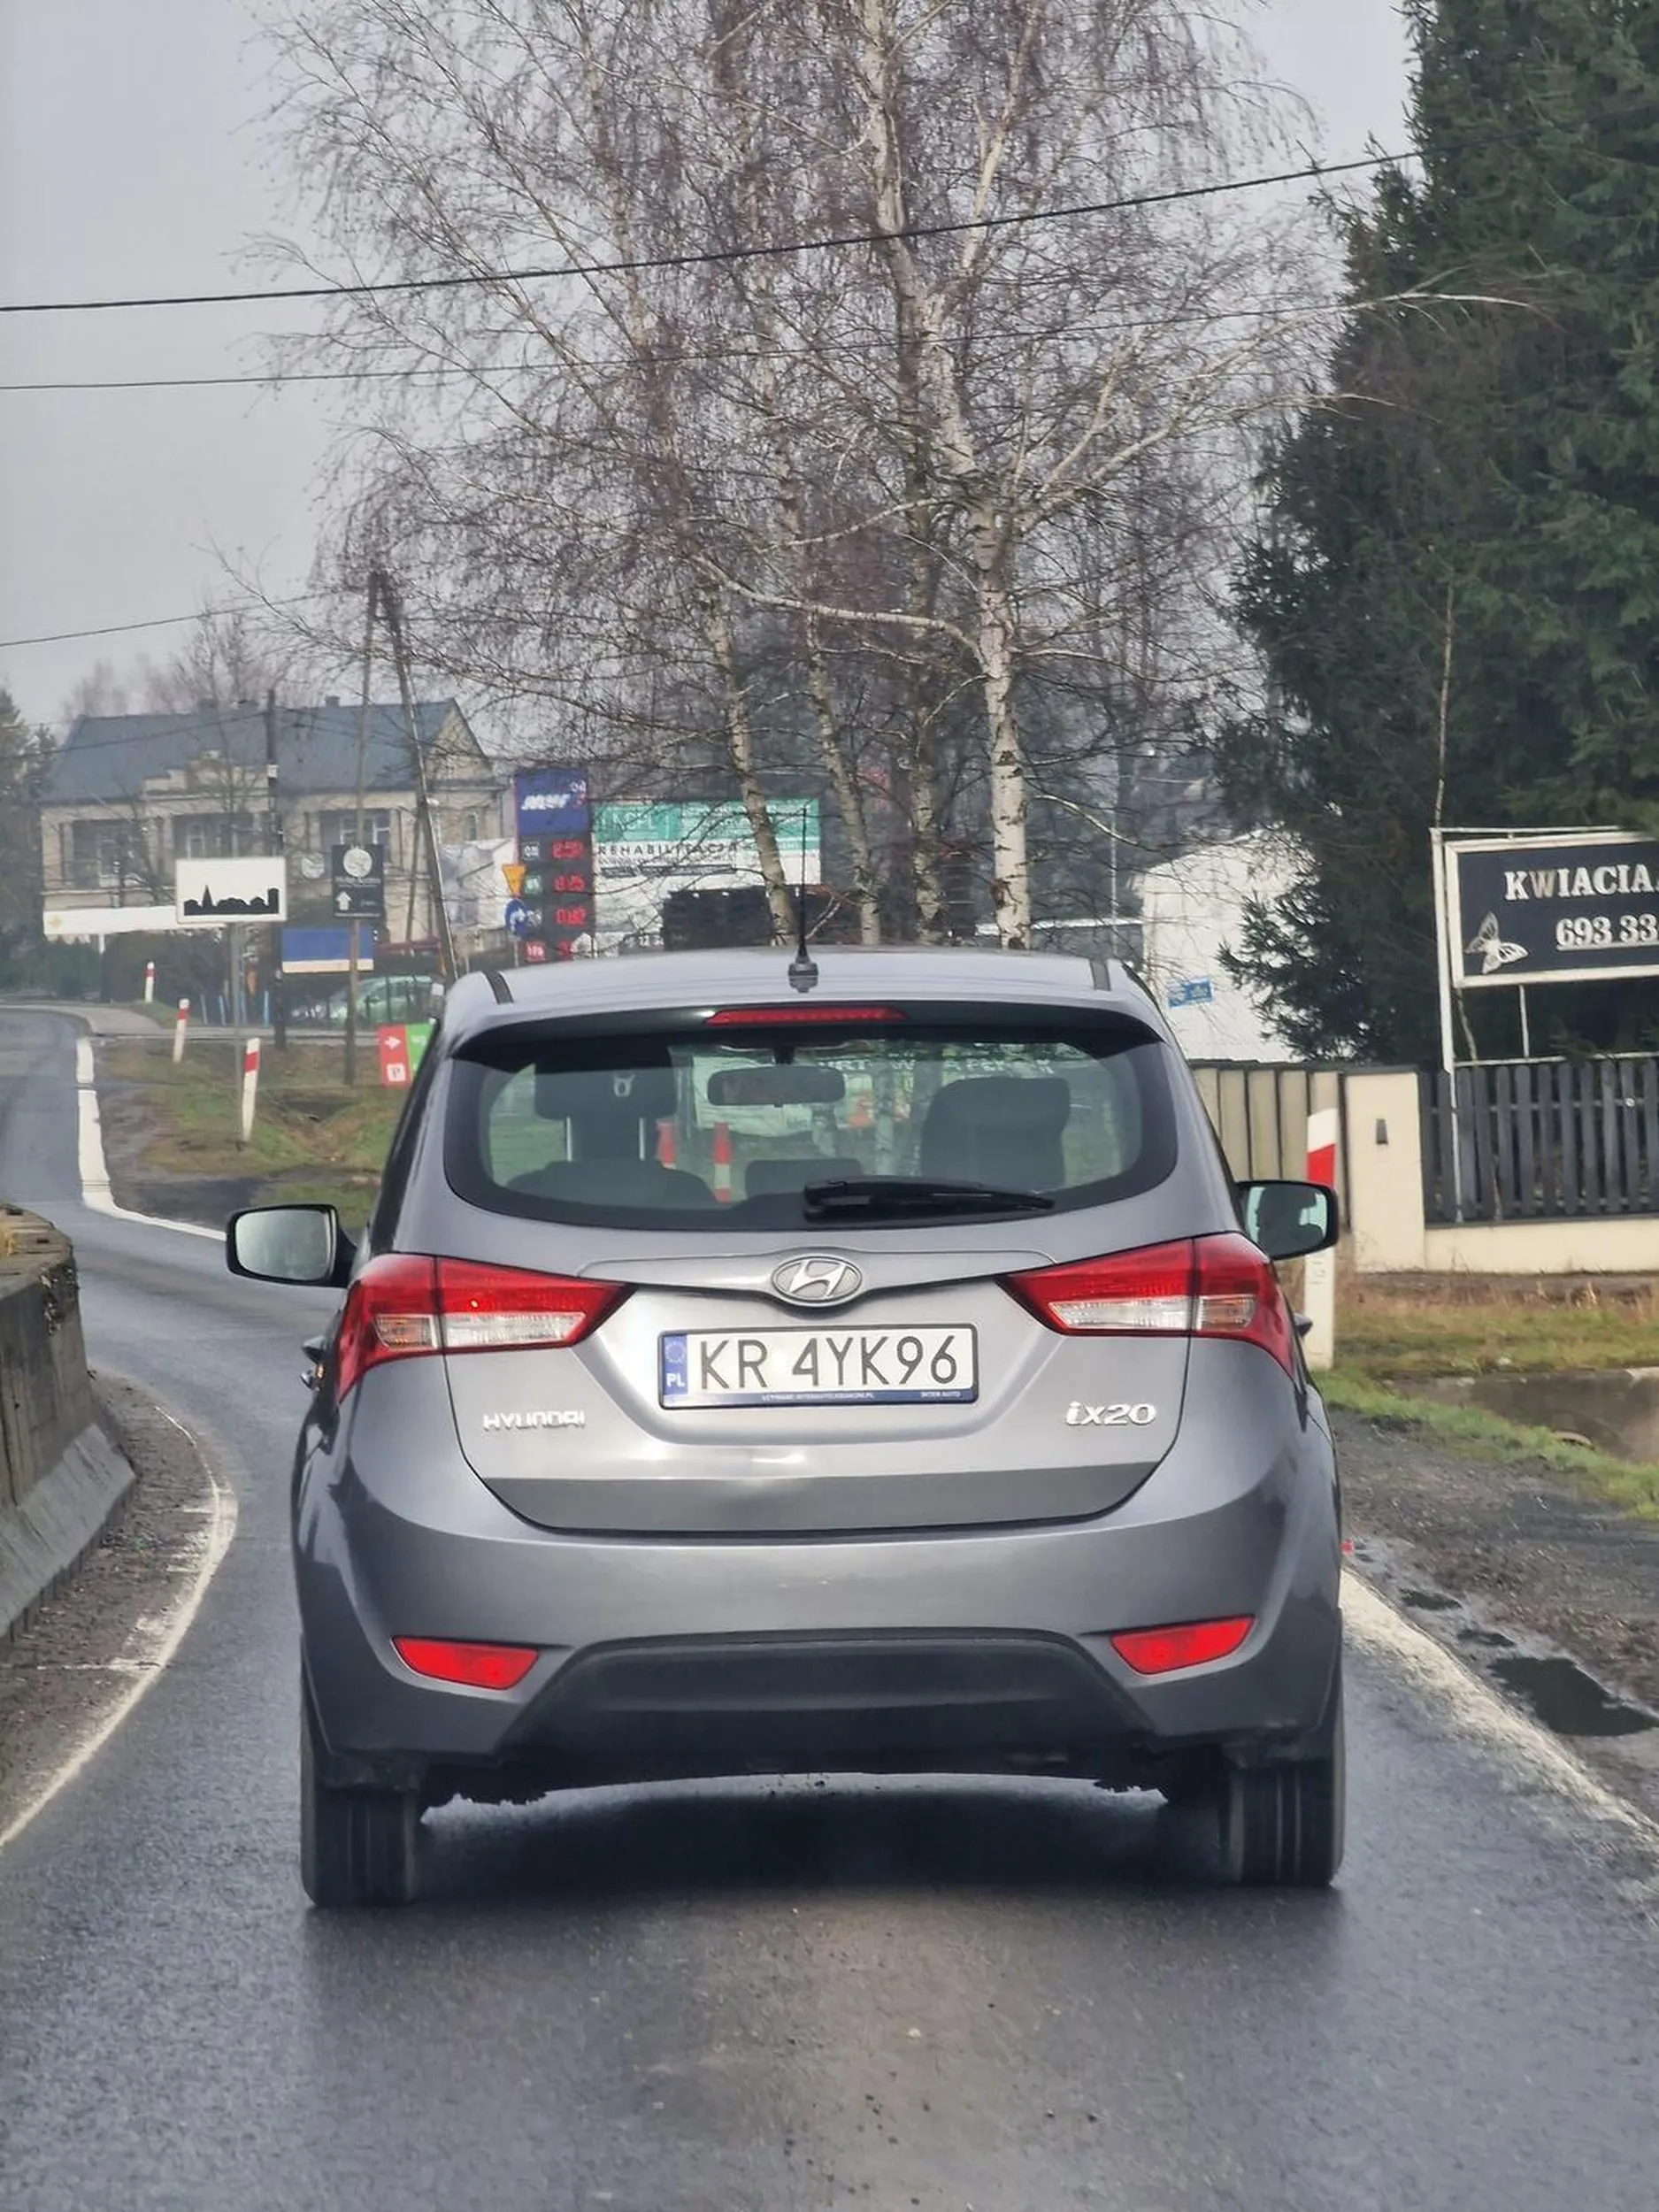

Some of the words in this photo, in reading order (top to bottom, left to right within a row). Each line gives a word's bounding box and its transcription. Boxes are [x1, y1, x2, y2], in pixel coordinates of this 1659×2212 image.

[1504, 864, 1659, 901] KWIACIA
[1555, 916, 1612, 947] 693
[700, 1339, 767, 1389] KR
[792, 1335, 957, 1386] 4YK96
[666, 1373, 686, 1386] PL
[483, 1410, 586, 1431] HYUNDAI
[1065, 1401, 1156, 1425] ix20
